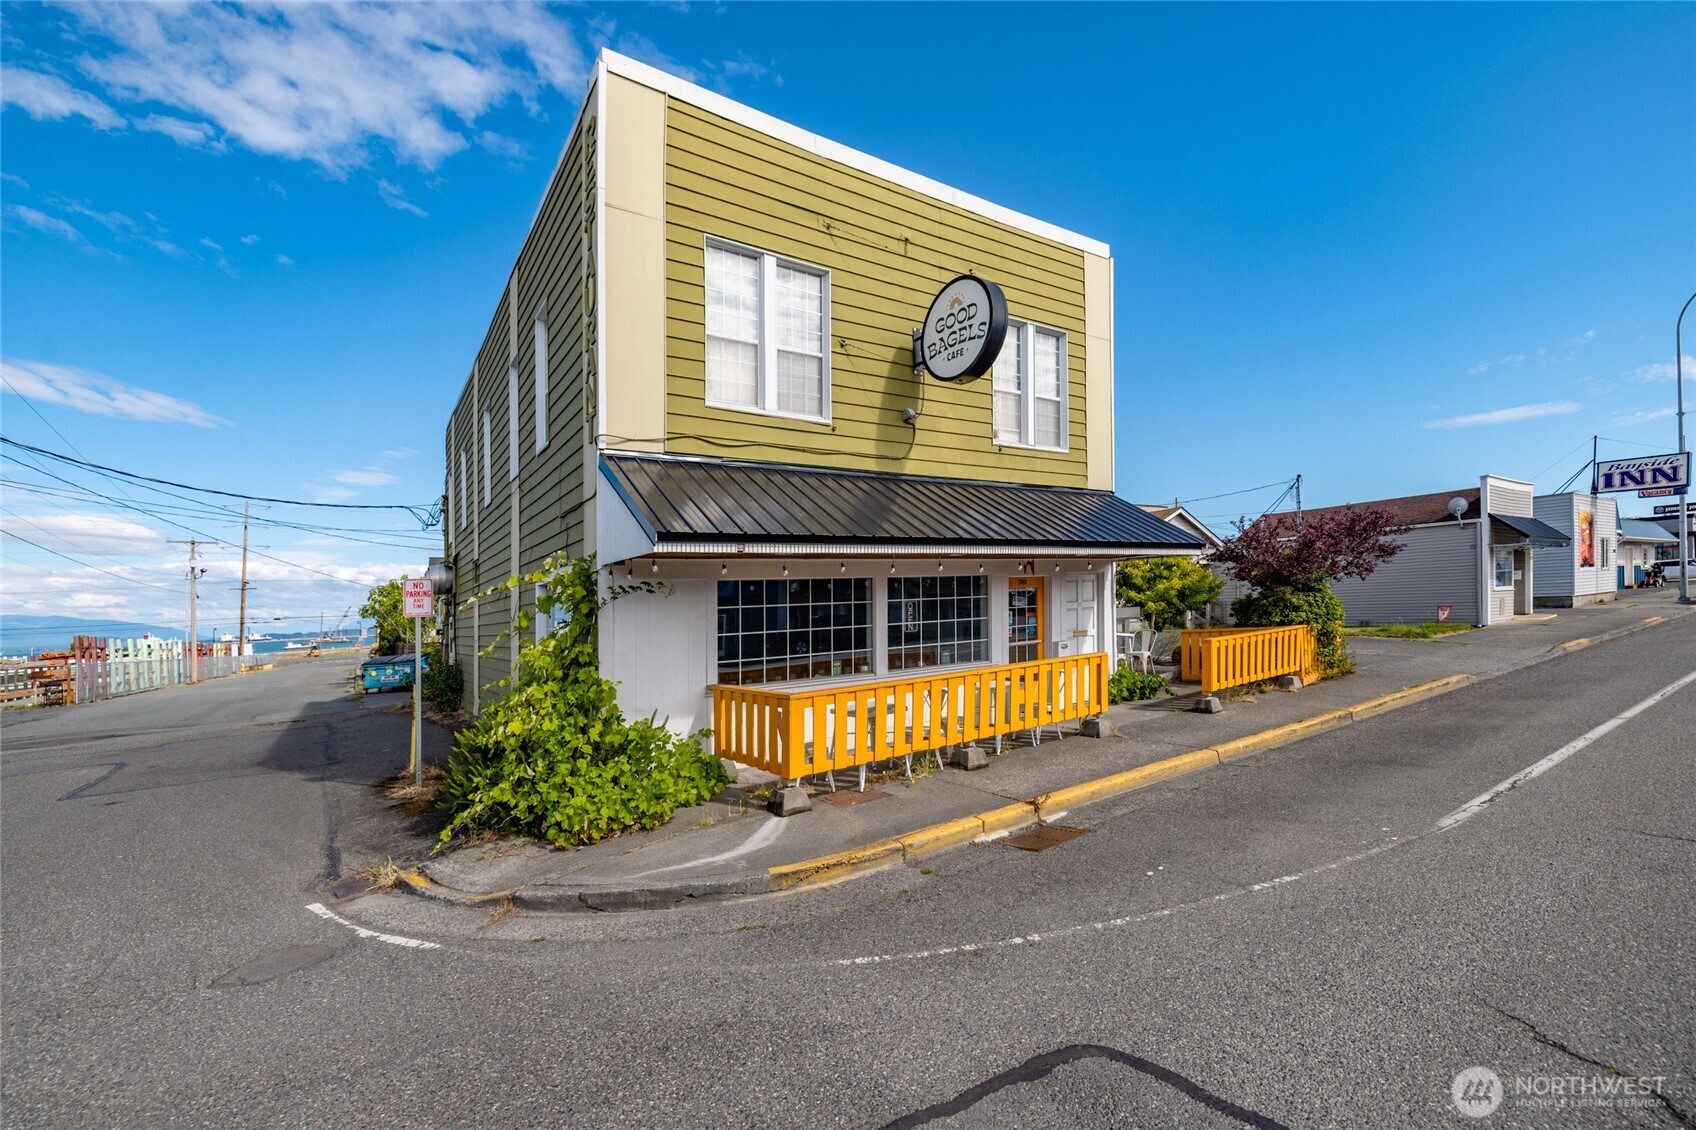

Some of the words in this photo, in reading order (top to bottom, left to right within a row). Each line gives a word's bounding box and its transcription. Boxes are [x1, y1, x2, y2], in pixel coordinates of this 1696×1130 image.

[935, 303, 978, 334] GOOD
[927, 321, 987, 360] BAGELS
[947, 347, 964, 361] CAFE
[1608, 456, 1680, 472] Bayside
[1601, 464, 1683, 490] INN
[1640, 489, 1673, 497] Vacancy
[412, 582, 425, 590] NO
[406, 590, 432, 598] PARKING
